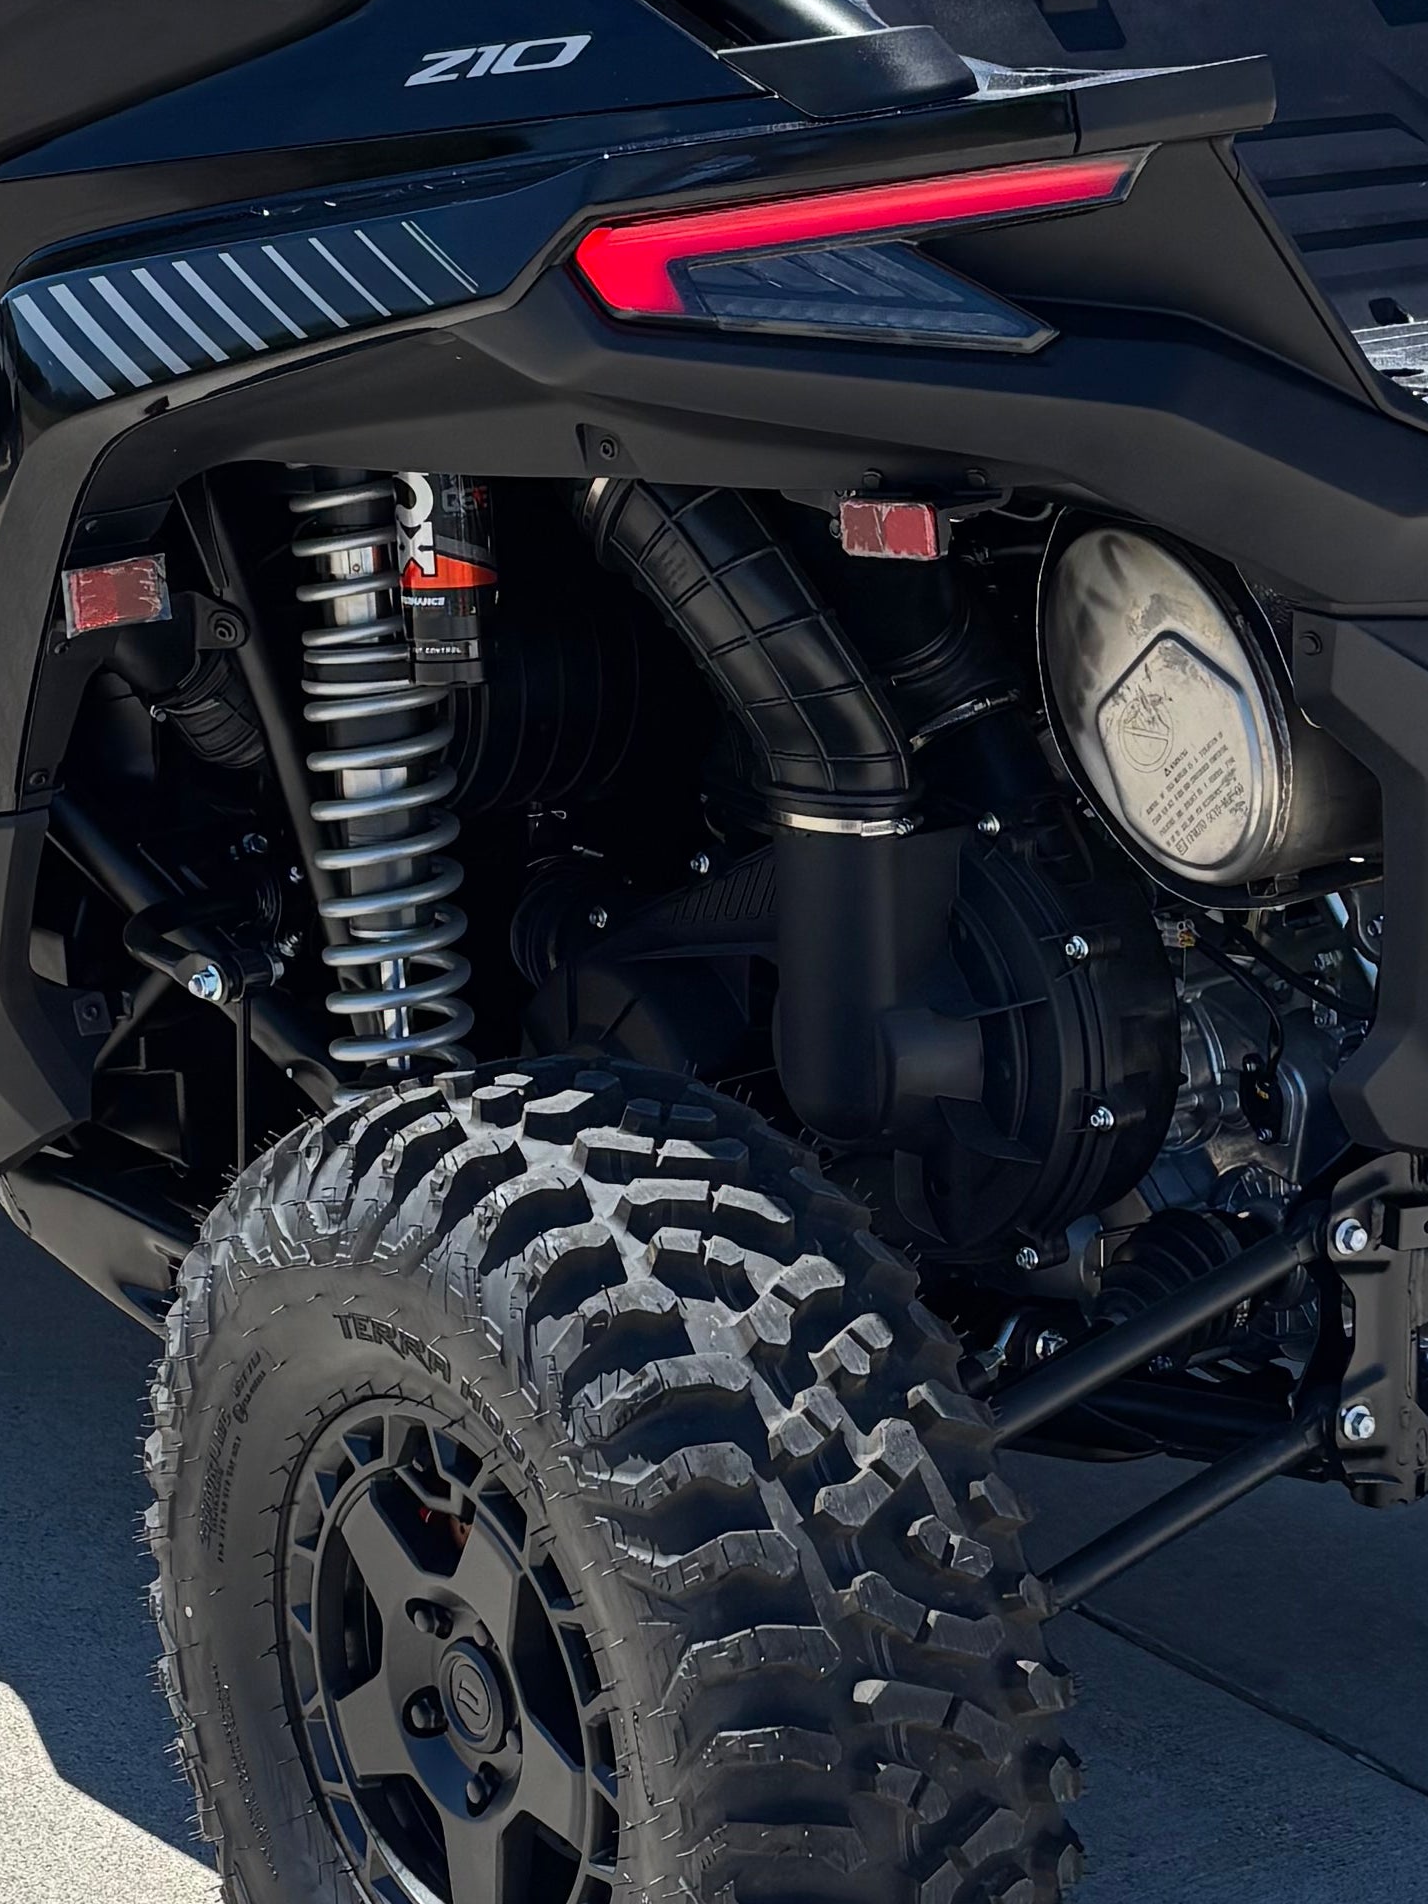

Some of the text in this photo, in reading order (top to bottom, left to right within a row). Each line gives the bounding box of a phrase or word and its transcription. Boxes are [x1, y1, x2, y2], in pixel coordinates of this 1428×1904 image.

[403, 34, 592, 87] Z10
[392, 472, 438, 576] OX
[332, 1311, 453, 1385] TERRA
